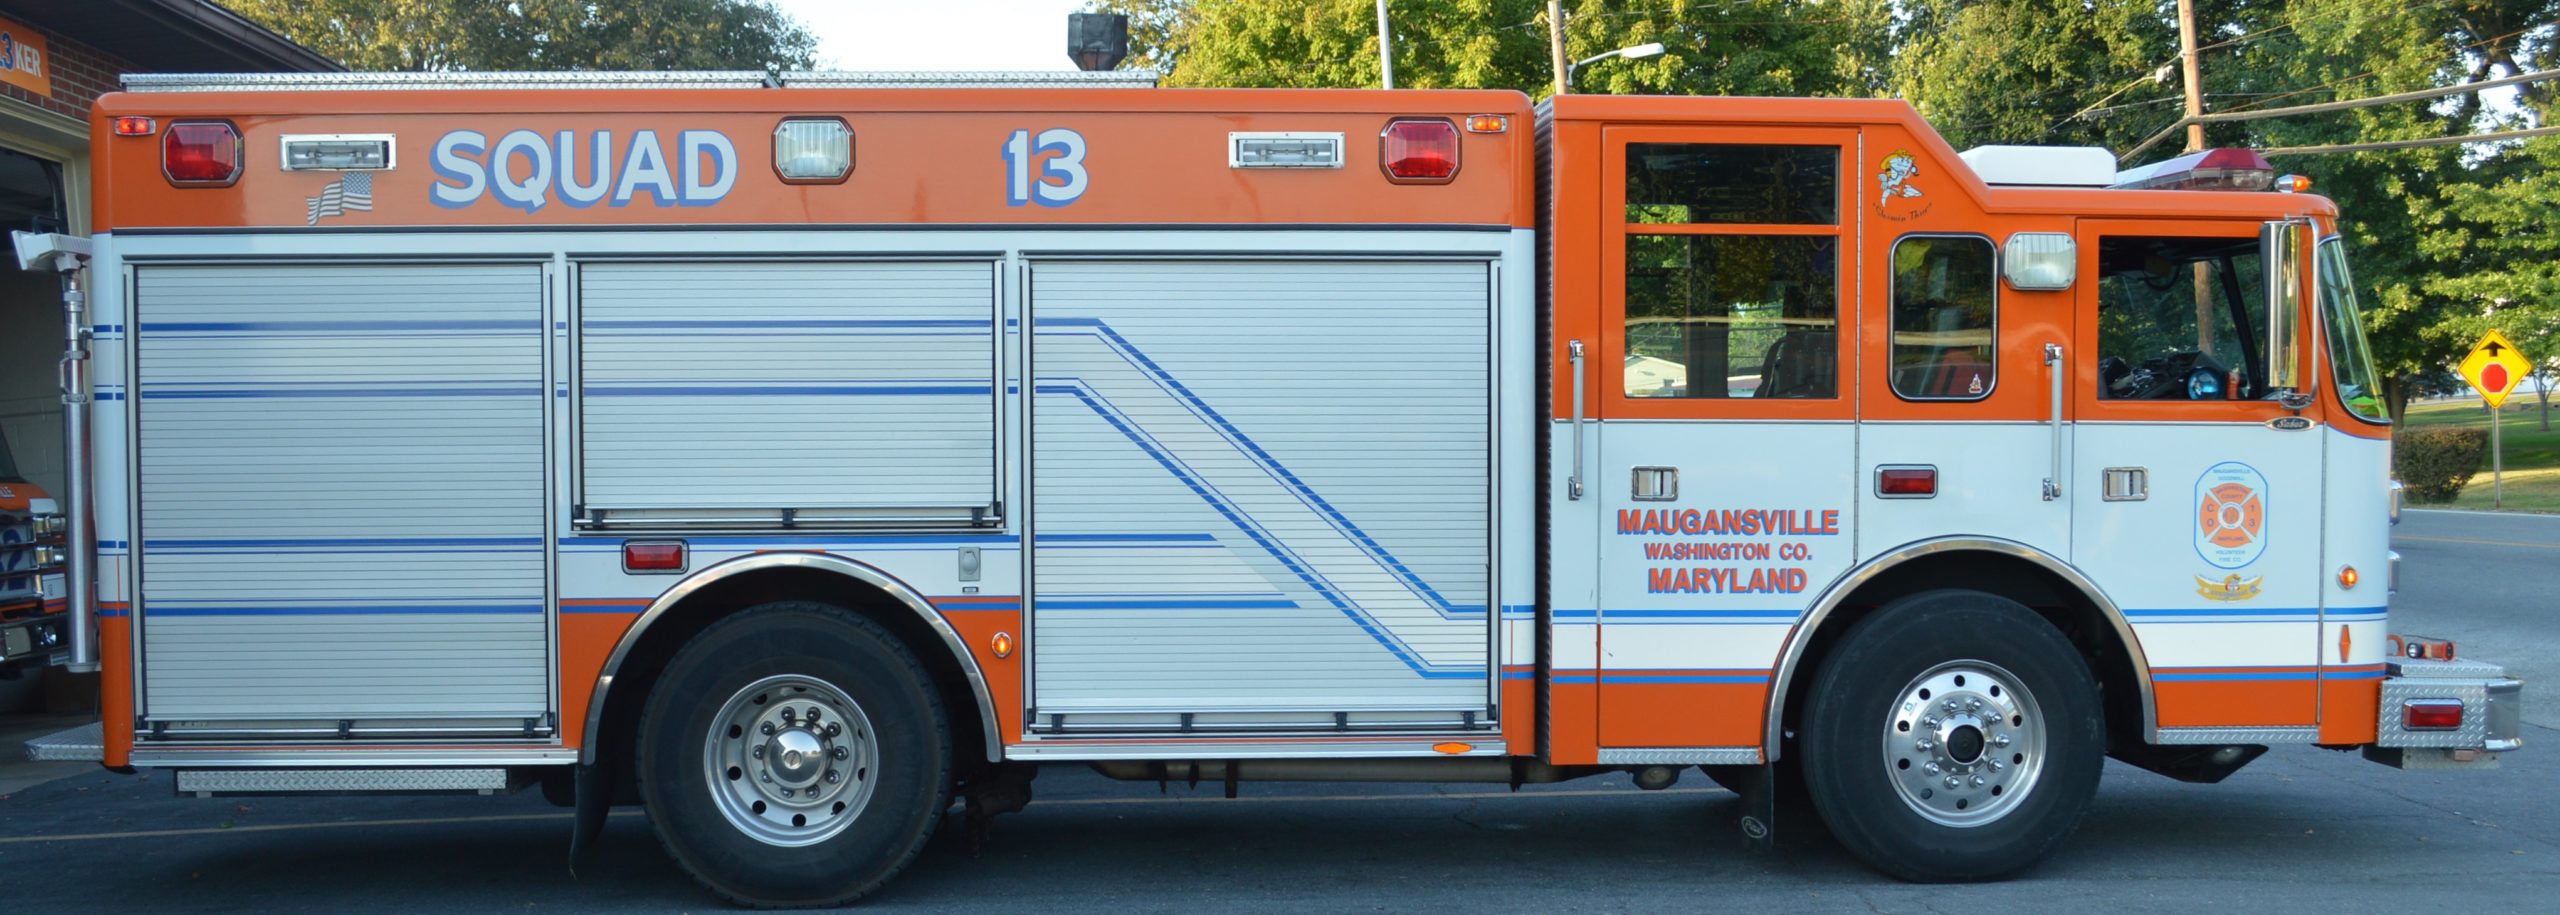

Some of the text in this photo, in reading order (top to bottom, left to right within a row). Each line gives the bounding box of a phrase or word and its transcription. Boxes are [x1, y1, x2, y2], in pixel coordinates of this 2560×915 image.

[14, 41, 42, 78] KER
[428, 127, 1089, 216] SQUAD 13
[1617, 509, 1839, 535] MAUGANSVILLE
[1644, 542, 1812, 560] WASHINGTON CO.
[1648, 567, 1807, 594] MARYLAND
